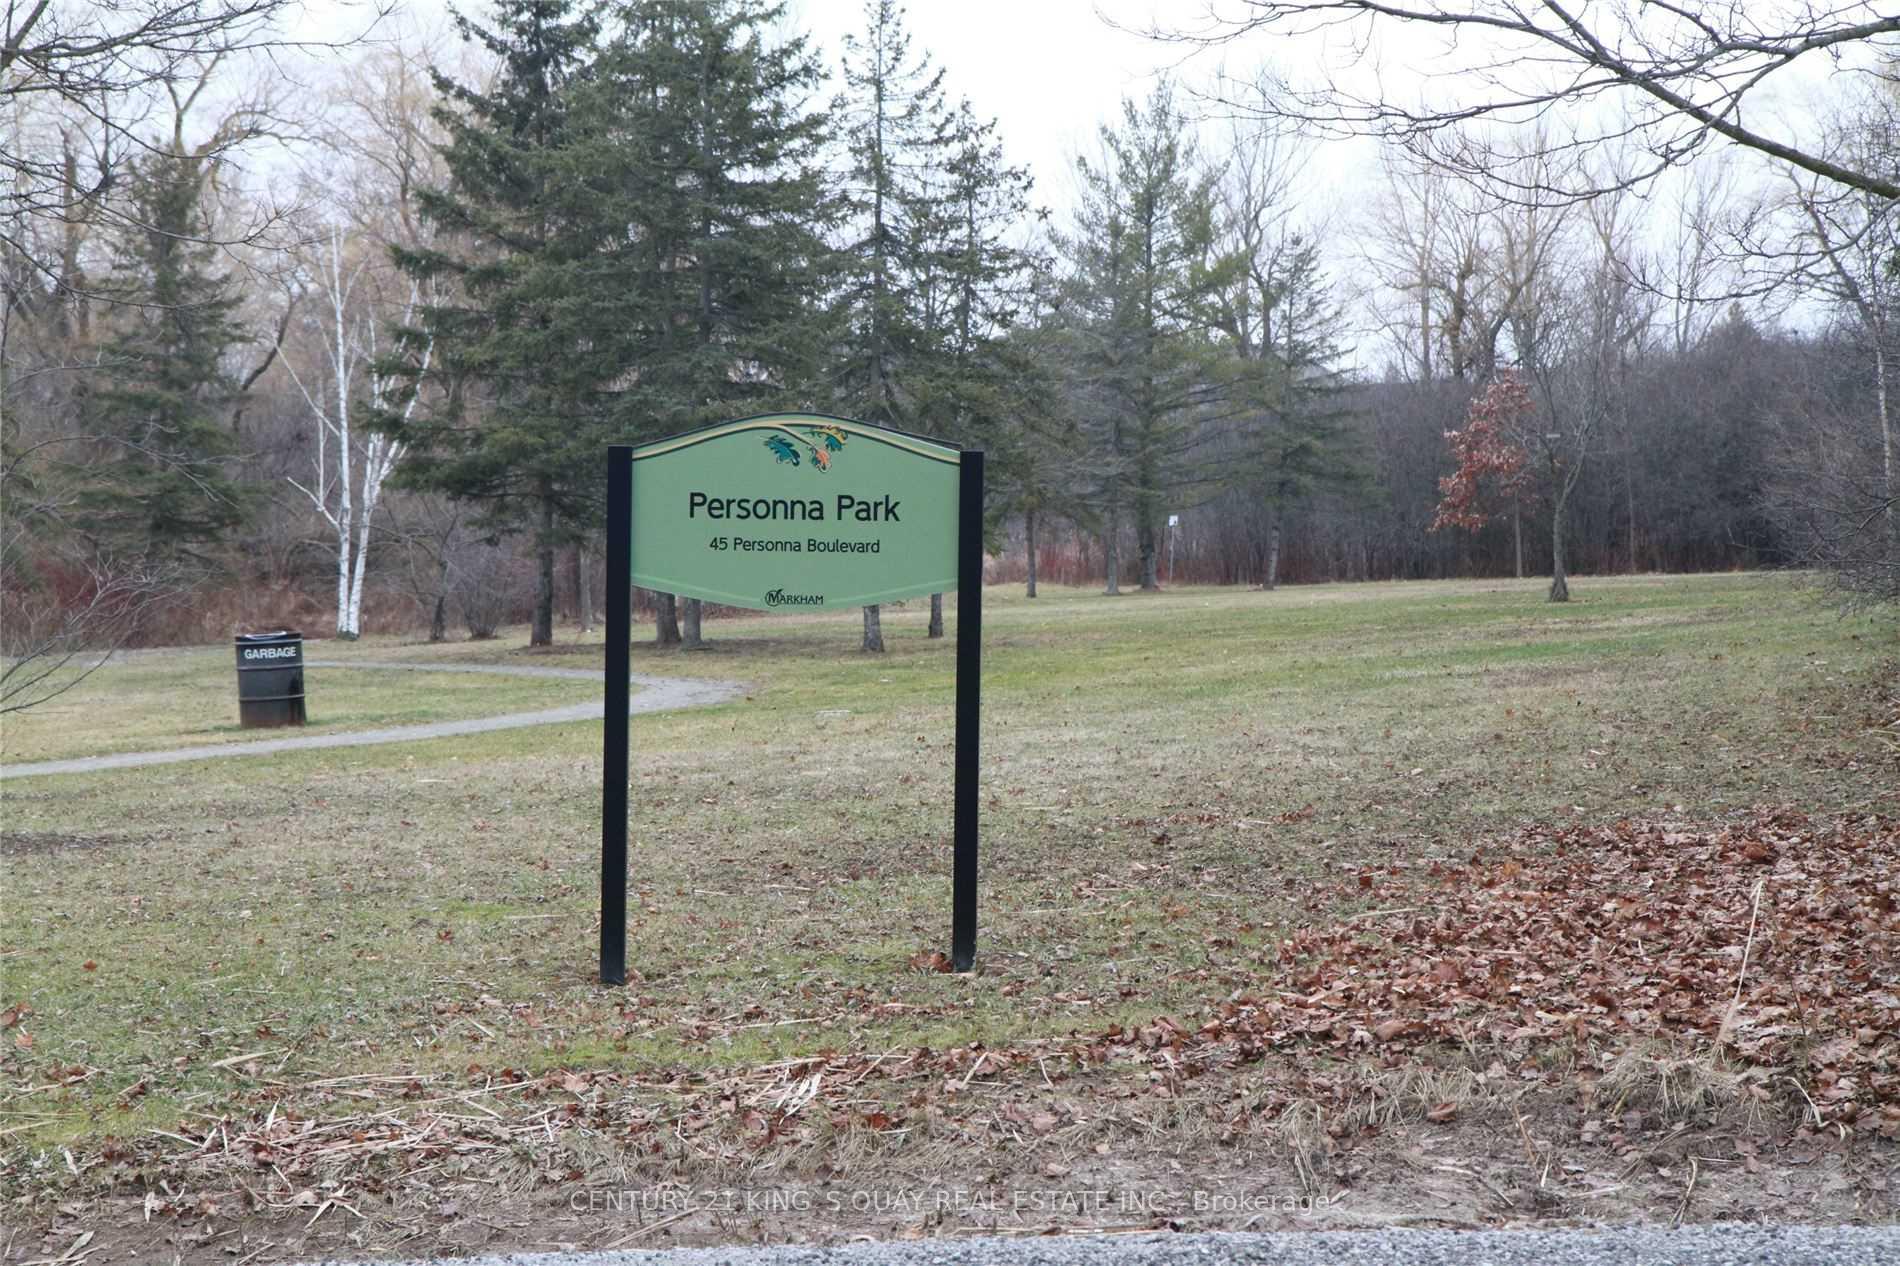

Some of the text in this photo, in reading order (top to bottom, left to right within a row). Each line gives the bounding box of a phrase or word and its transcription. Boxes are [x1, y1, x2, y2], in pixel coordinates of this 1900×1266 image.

[689, 492, 901, 522] Personna Park
[709, 537, 880, 553] 45 Personna Boulevard
[765, 588, 824, 607] MARKHAM
[244, 646, 297, 660] GARBAGE
